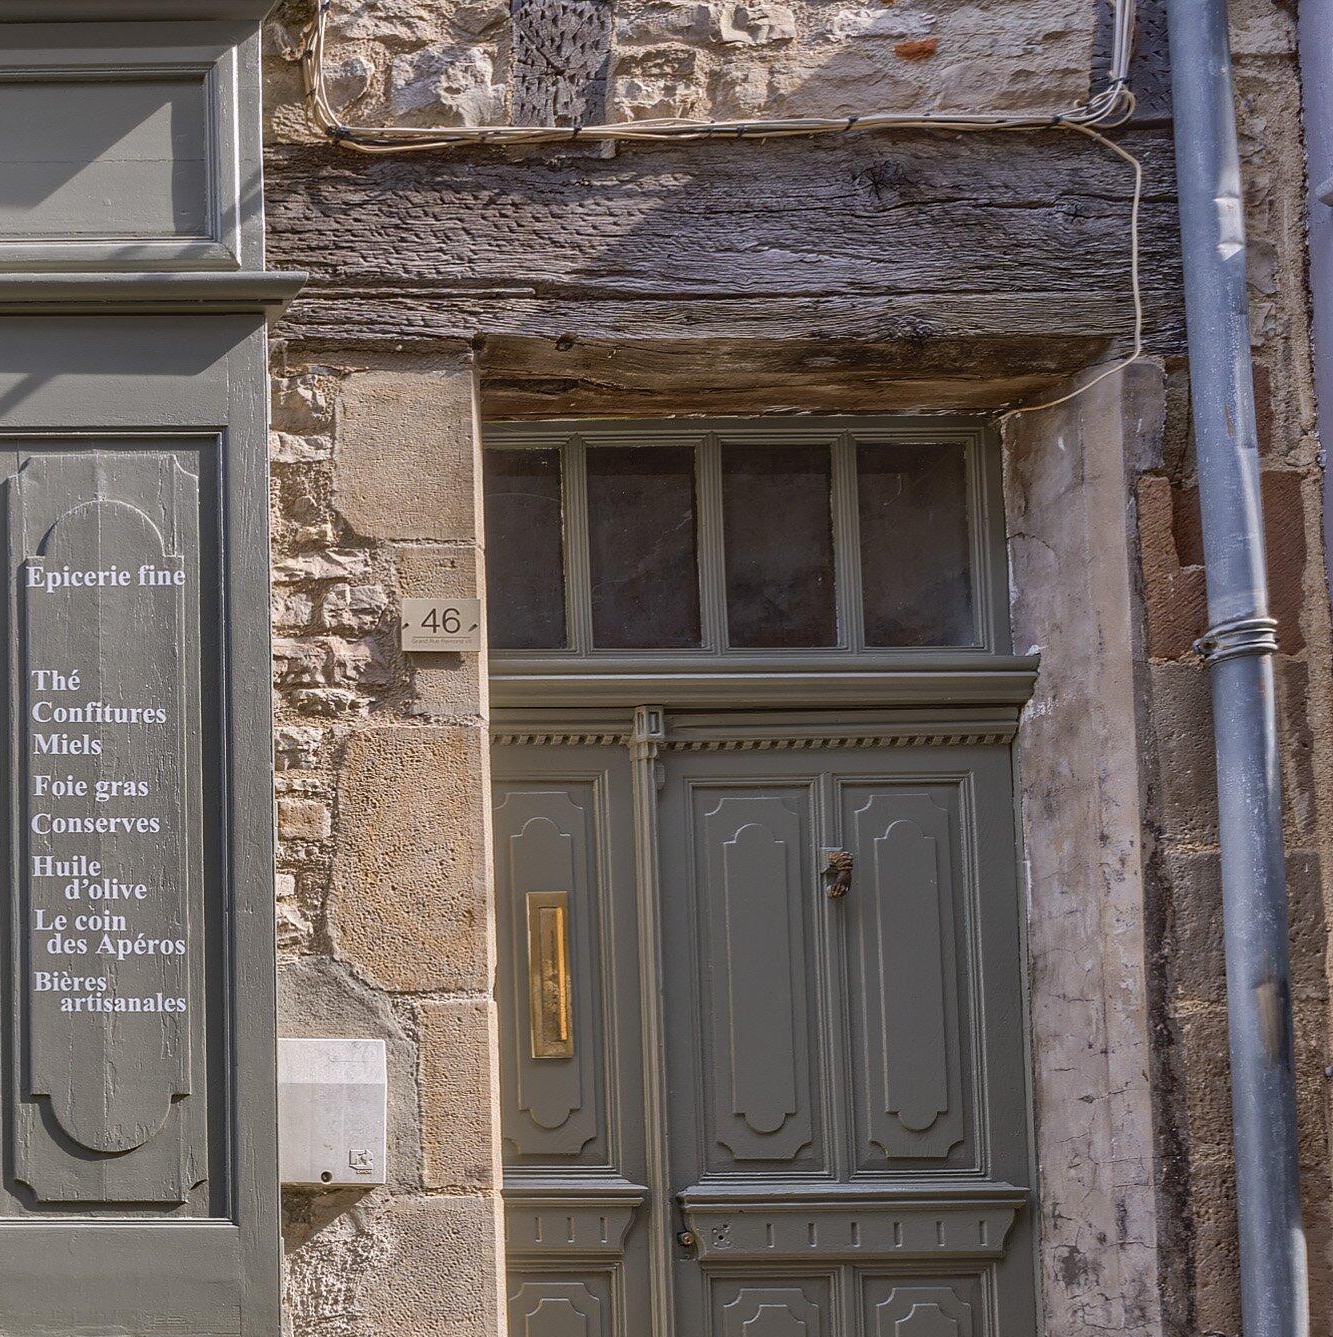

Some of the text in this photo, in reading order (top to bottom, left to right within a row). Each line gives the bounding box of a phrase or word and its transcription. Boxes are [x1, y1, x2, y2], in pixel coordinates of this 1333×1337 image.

[25, 565, 186, 593] Epicerie fine
[421, 608, 461, 633] 46
[31, 669, 80, 691] Thé
[32, 701, 167, 724] Confitures
[33, 734, 101, 755] Miels
[34, 775, 149, 802] Foie gras
[31, 814, 161, 835] Conserves
[32, 855, 101, 877] Huile
[34, 909, 126, 931] Le coin
[47, 932, 187, 960] des Apéros
[34, 971, 107, 993] Bières
[60, 991, 187, 1013] artisanales
